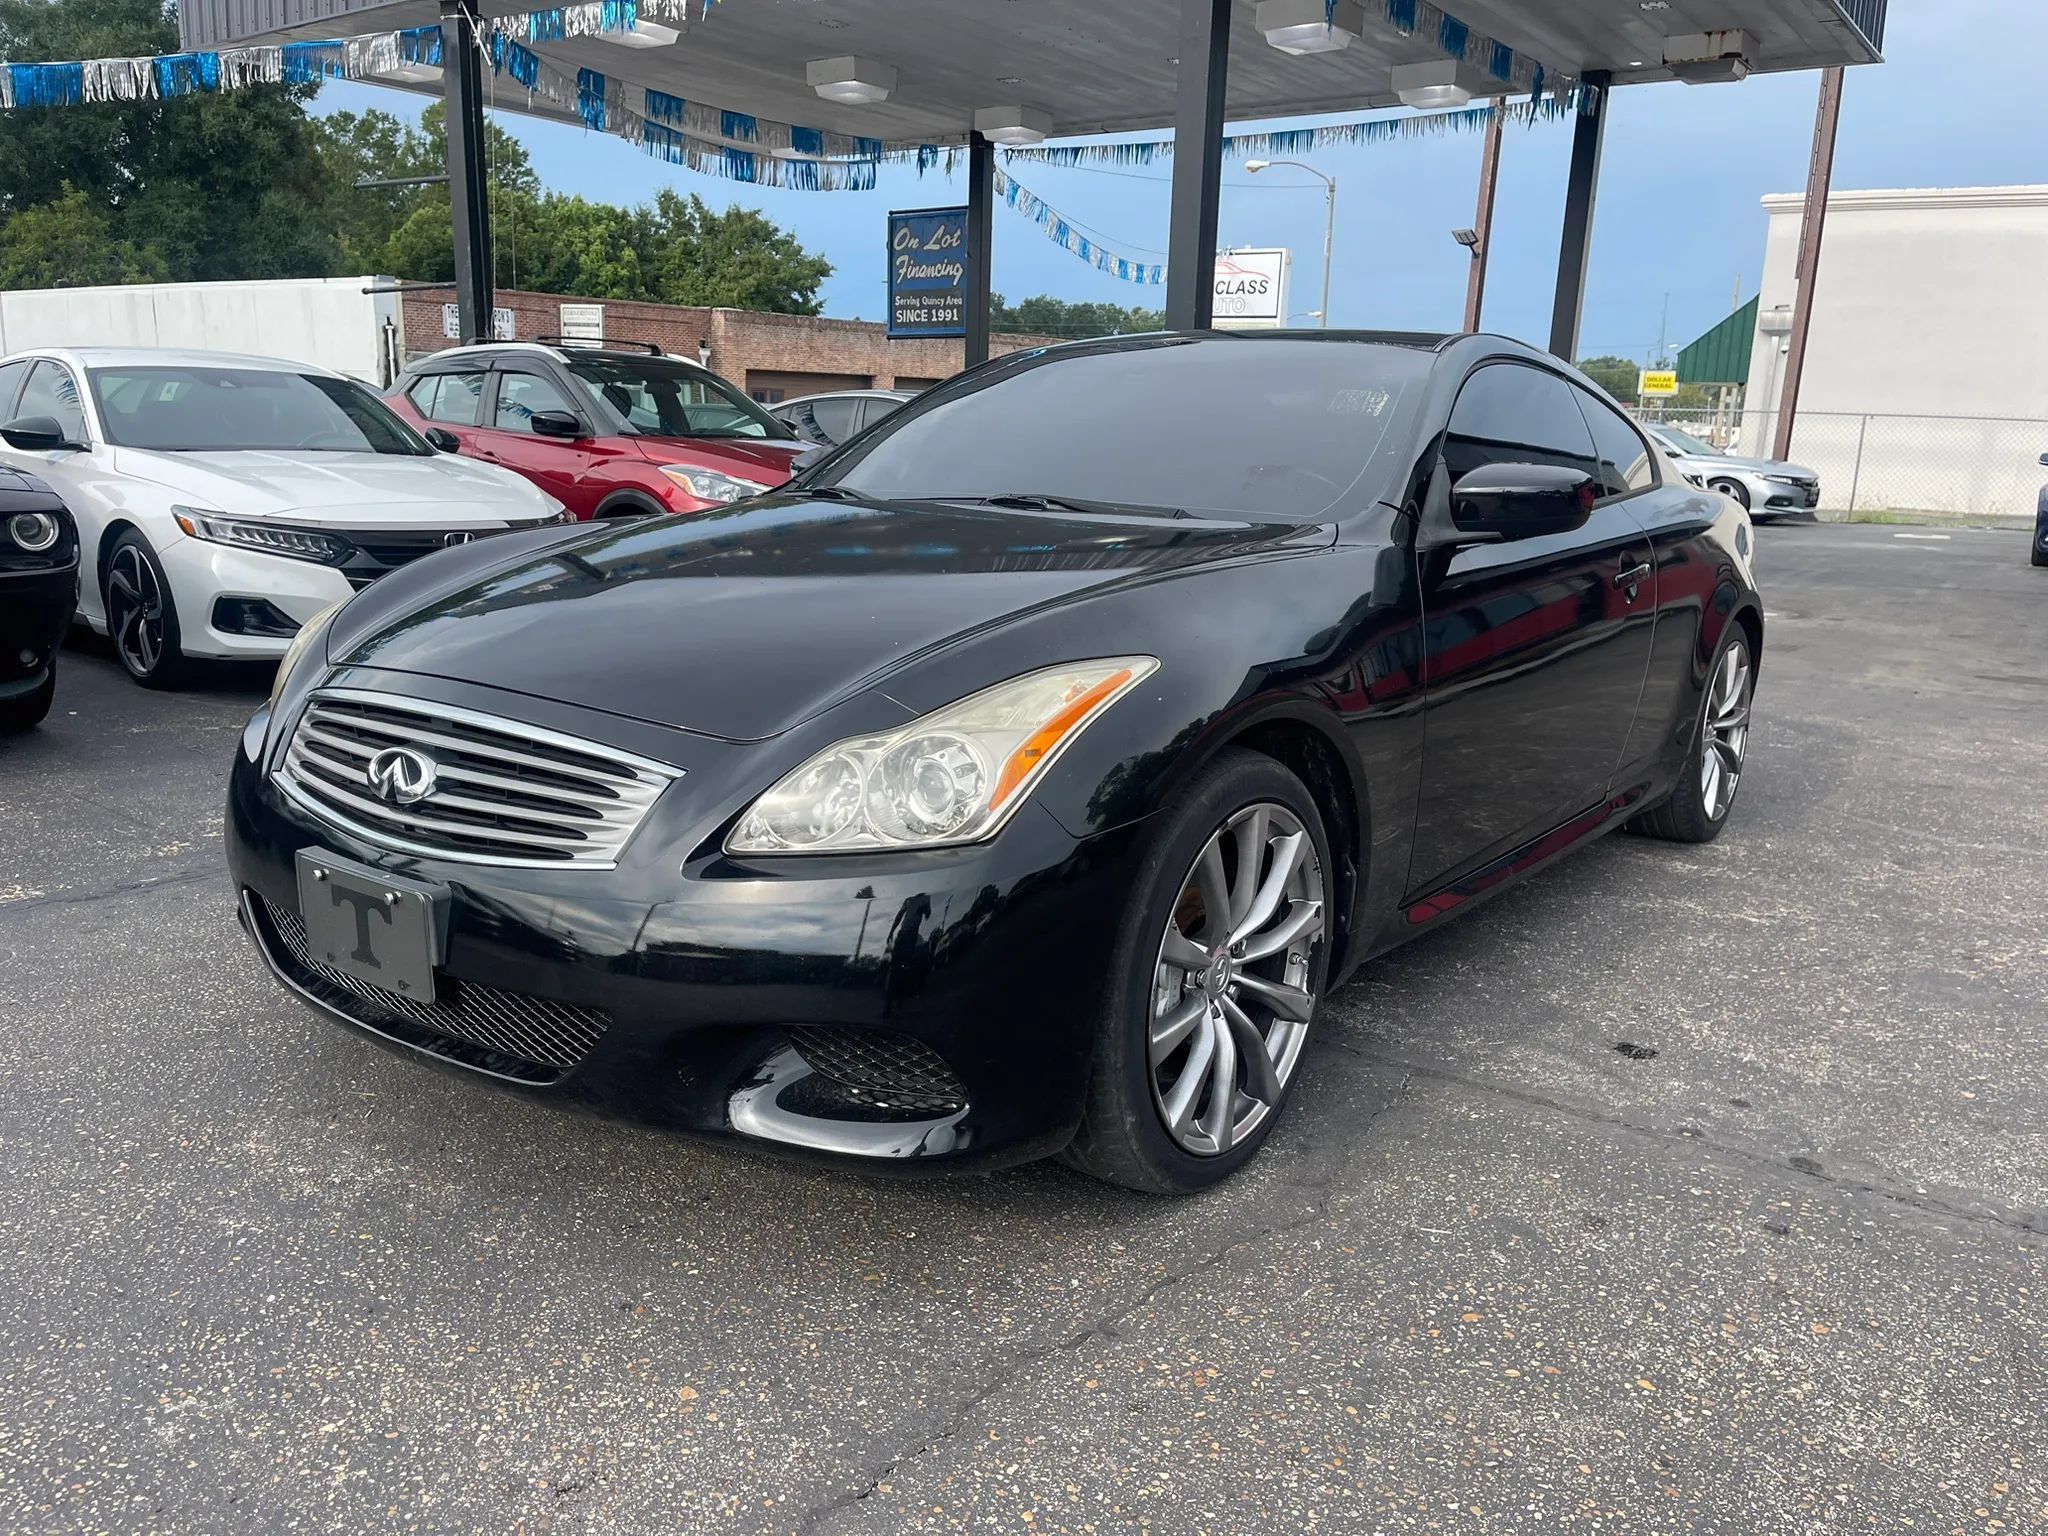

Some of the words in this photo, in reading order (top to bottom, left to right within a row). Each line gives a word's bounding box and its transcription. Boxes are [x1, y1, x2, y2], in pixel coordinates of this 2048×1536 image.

[893, 227, 919, 250] On
[923, 224, 961, 250] Lot
[896, 254, 963, 286] Financing
[1215, 279, 1269, 295] CLASS
[895, 295, 920, 307] Serving
[921, 296, 945, 307] Quincy
[946, 295, 963, 305] Area
[1213, 297, 1246, 314] UTO
[896, 309, 928, 323] SINCE
[931, 308, 959, 321] 1991
[330, 883, 393, 970] T
